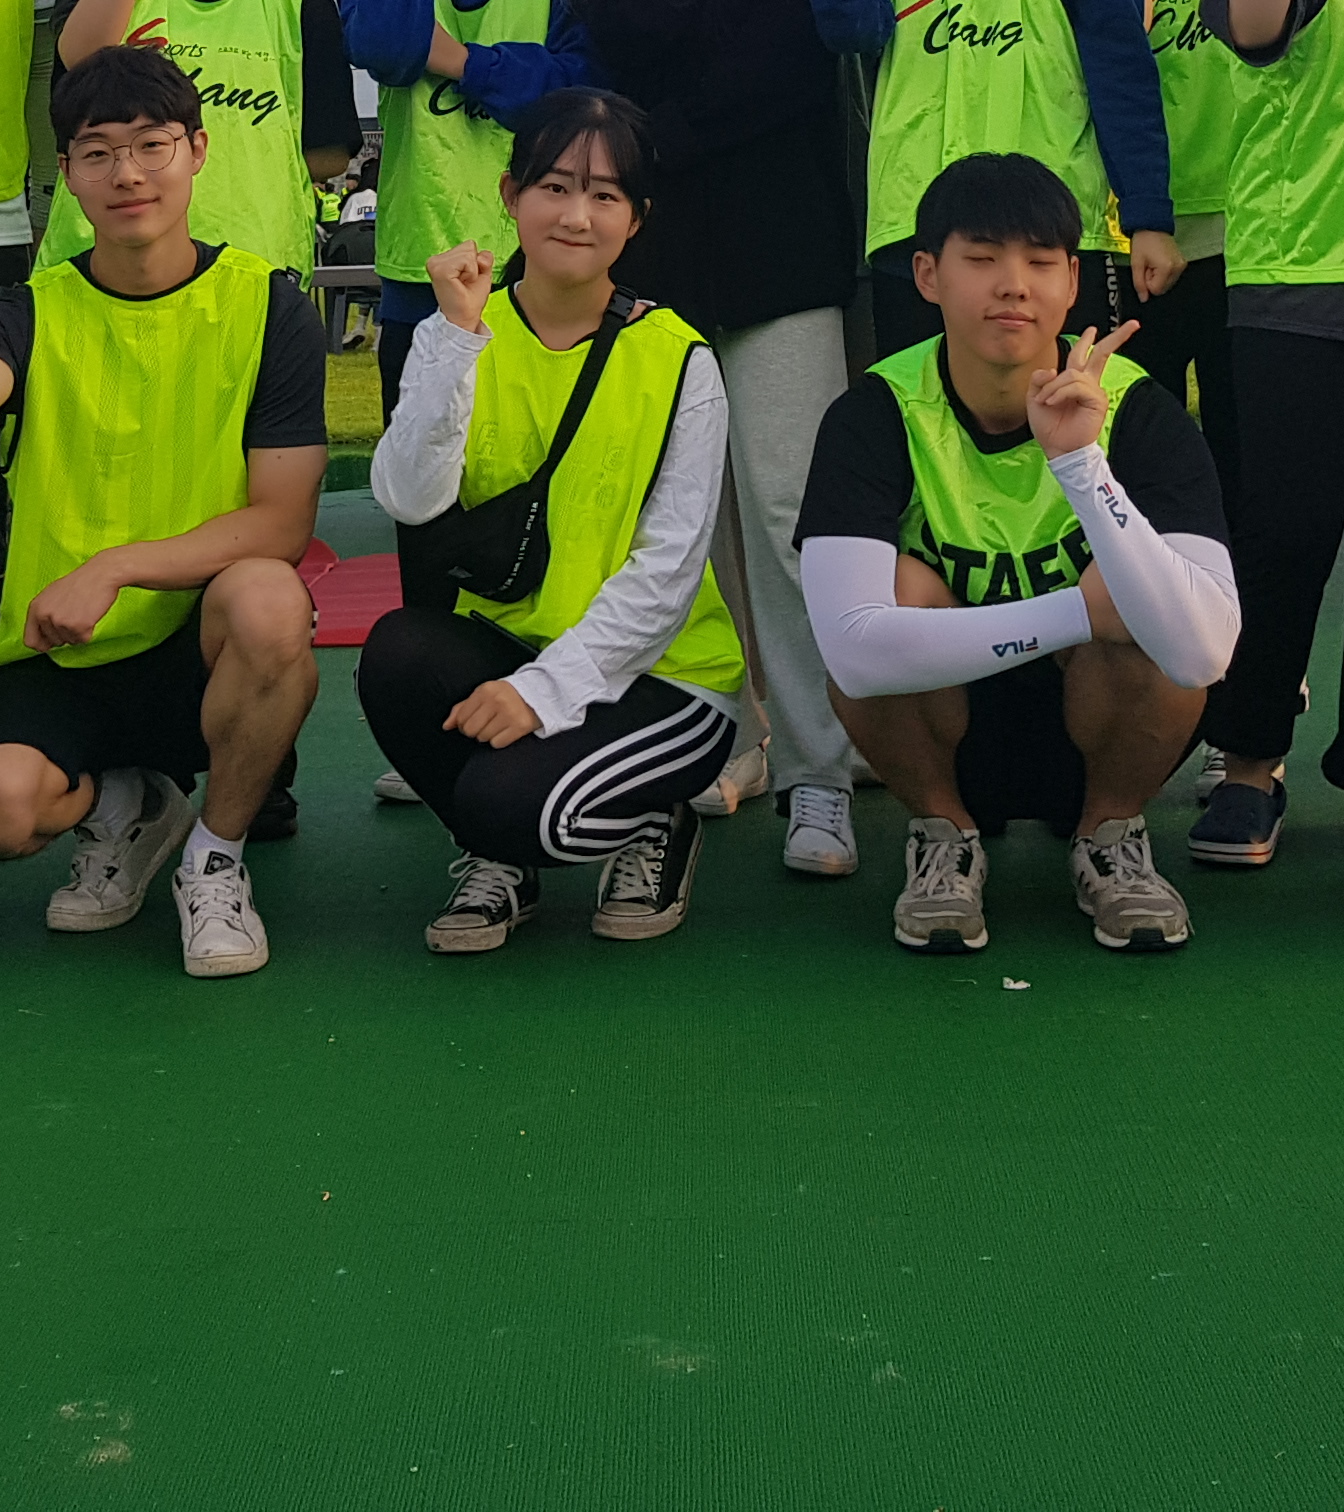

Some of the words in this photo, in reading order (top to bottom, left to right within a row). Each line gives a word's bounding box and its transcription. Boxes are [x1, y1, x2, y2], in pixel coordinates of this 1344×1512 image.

[186, 67, 281, 127] ang
[1097, 482, 1128, 530] FILA
[906, 522, 1094, 607] STAFF
[992, 636, 1039, 658] FILA
